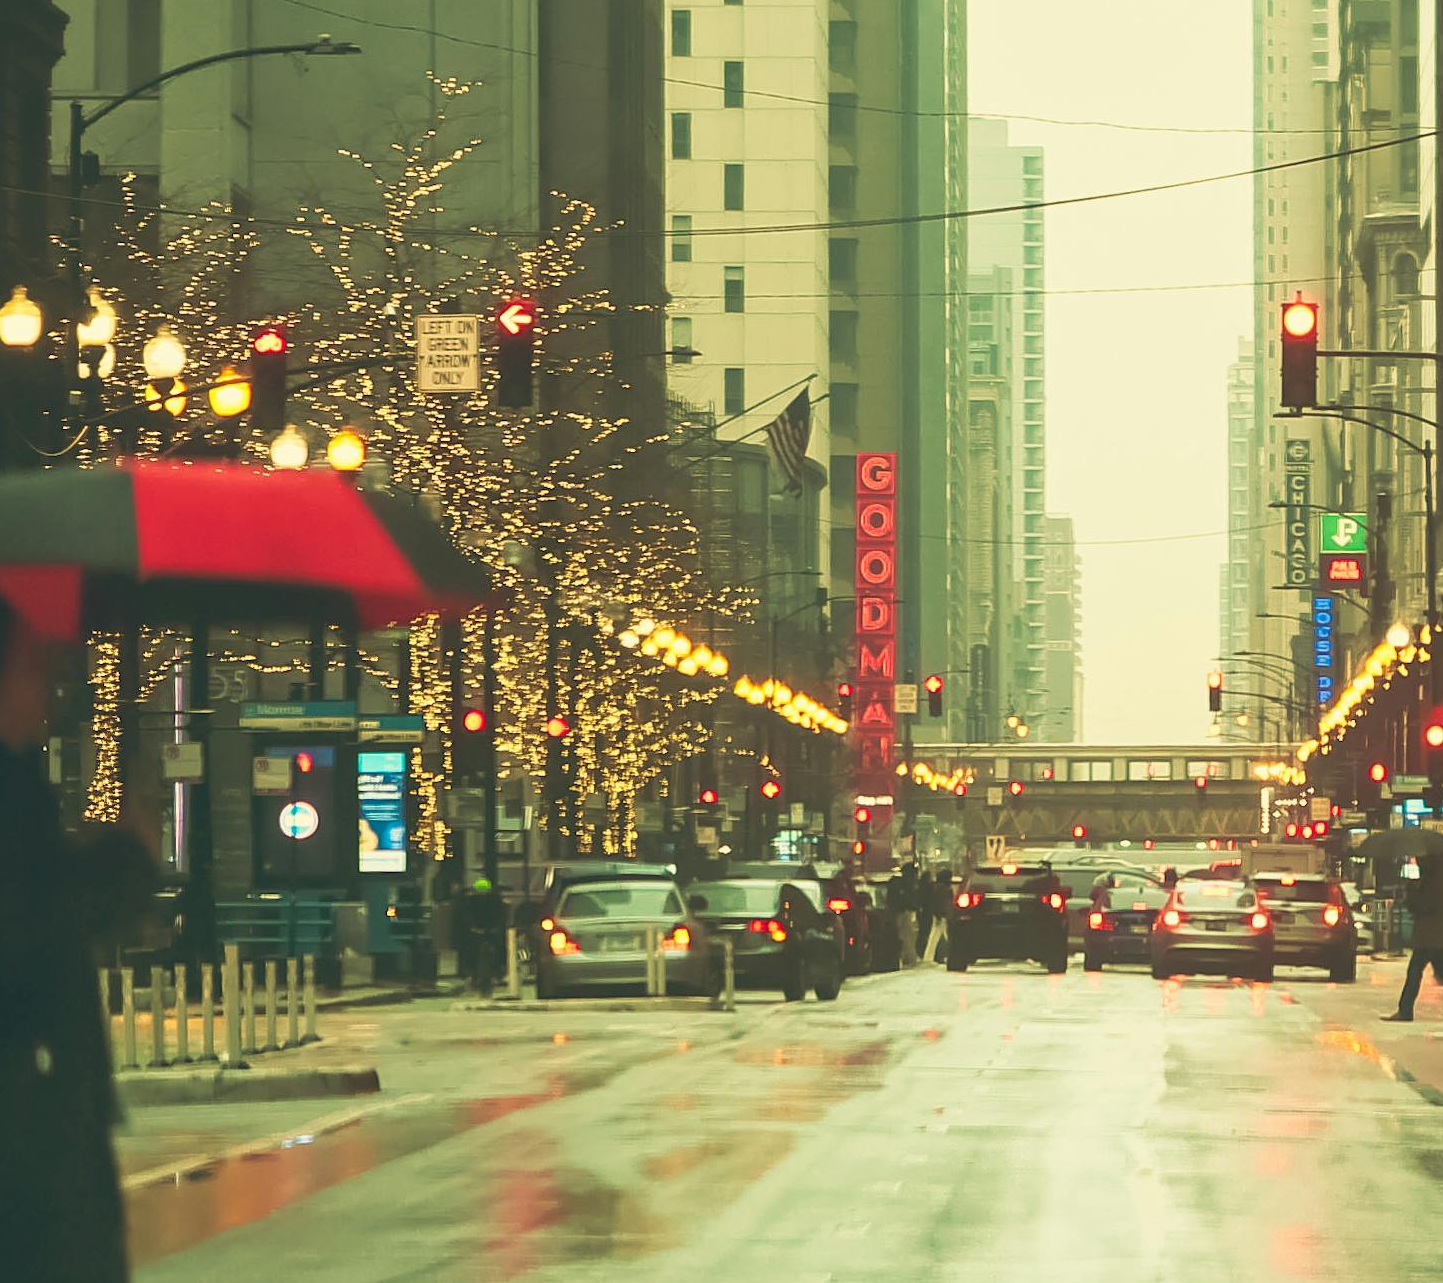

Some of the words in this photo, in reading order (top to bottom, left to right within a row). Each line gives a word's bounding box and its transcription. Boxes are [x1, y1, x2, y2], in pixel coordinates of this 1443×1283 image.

[423, 321, 452, 334] LEFT
[457, 321, 475, 334] ON
[428, 338, 468, 351] GREEN
[433, 371, 465, 385] ONLY
